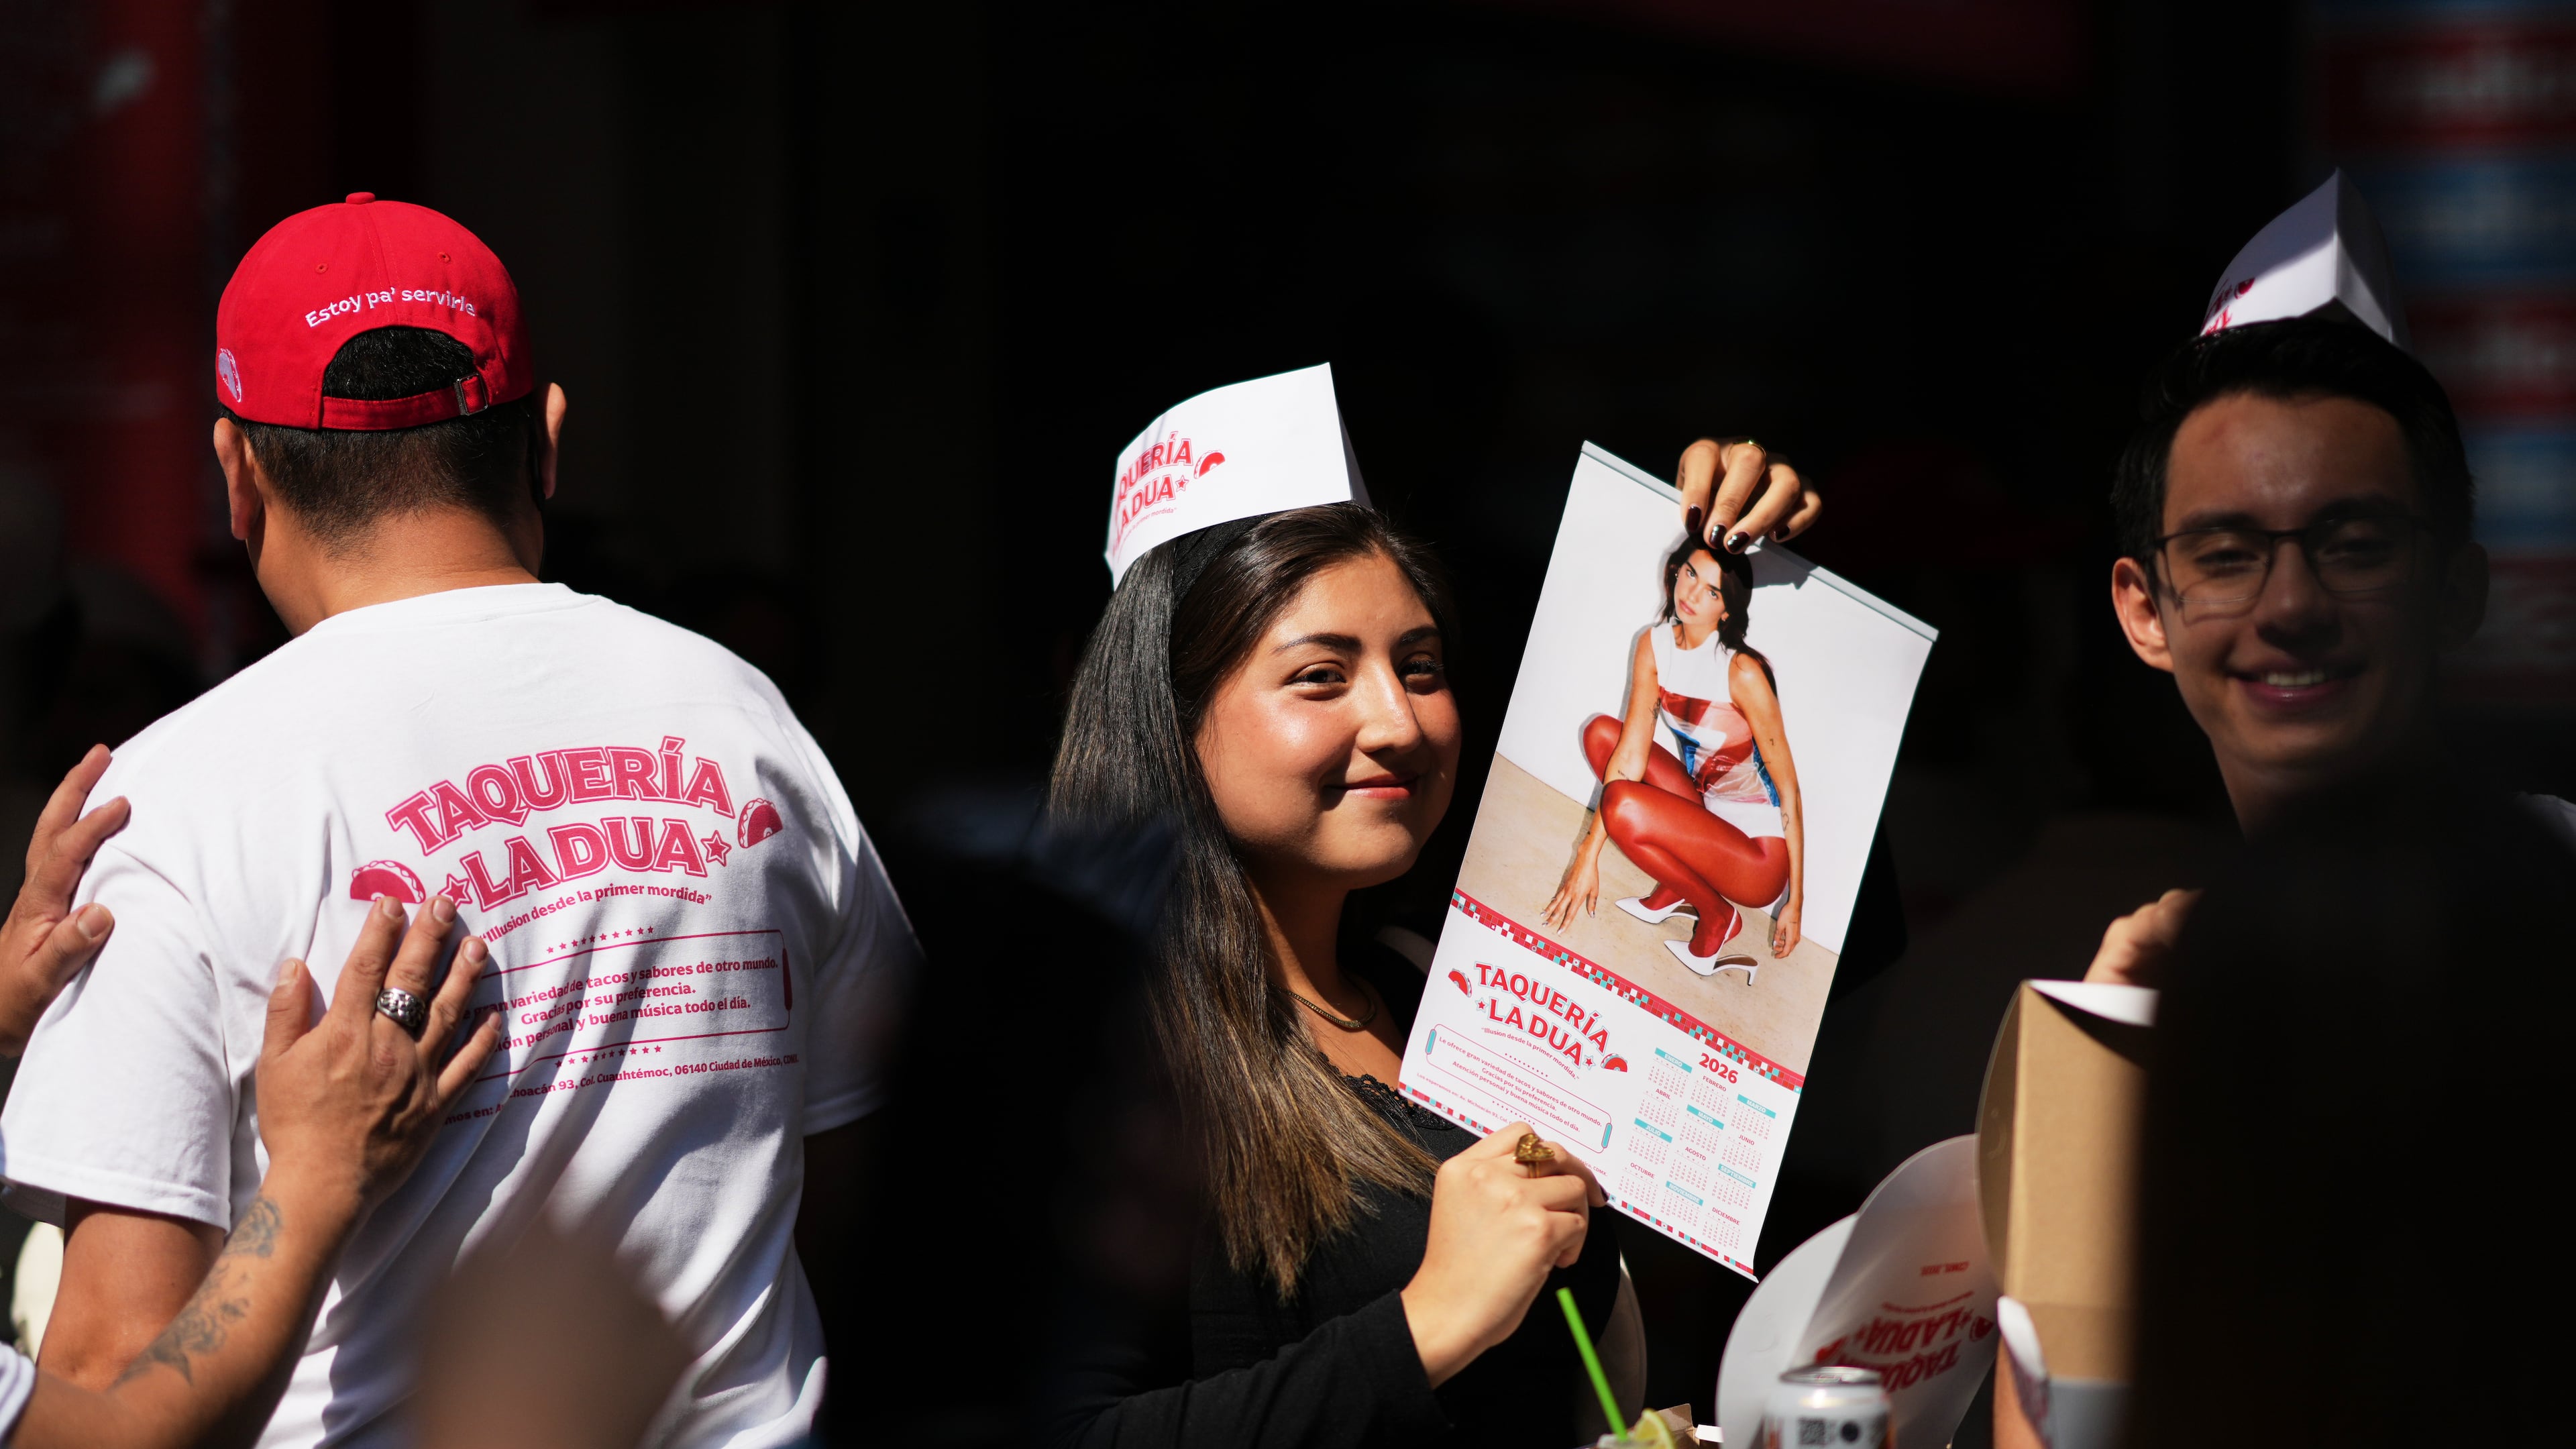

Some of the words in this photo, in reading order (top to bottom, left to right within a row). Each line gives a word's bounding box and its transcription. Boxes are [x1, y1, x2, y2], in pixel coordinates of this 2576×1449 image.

[305, 294, 362, 328] Estoy
[365, 286, 396, 309] pa’
[401, 288, 476, 317] servirle
[1116, 431, 1193, 511] QUERÍA
[1131, 474, 1175, 521] DUA
[386, 735, 736, 857] TAQUERÍA
[531, 896, 576, 920] desde
[577, 890, 593, 902] la
[594, 883, 645, 902] primer
[647, 885, 712, 906] mordida”
[511, 981, 570, 1009] variedad
[570, 978, 584, 993] de
[586, 972, 629, 989] tacos
[630, 971, 640, 984] y
[639, 964, 694, 981] sabores
[696, 961, 713, 974] de
[715, 960, 741, 973] otro
[742, 957, 778, 971] mundo.
[521, 1004, 566, 1026] Gracias
[566, 996, 591, 1015] por
[594, 994, 613, 1006] su
[616, 981, 696, 1006] preferencia.
[1474, 961, 1610, 1054] TAQUERÍA
[525, 1018, 574, 1048] personal
[576, 1018, 586, 1031] y
[589, 1010, 629, 1026] buena
[631, 1003, 683, 1019] música
[684, 999, 716, 1014] todo
[717, 998, 729, 1010] el
[729, 996, 751, 1010] día.
[1489, 998, 1524, 1030] LA
[1527, 1013, 1582, 1068] DUA
[1507, 1033, 1526, 1044] desde
[1526, 1040, 1532, 1048] la
[1532, 1044, 1553, 1059] primer
[1664, 1053, 1682, 1067] ENERO
[558, 1079, 578, 1091] 93,
[580, 1075, 596, 1087] Col.
[596, 1067, 674, 1084] Cuauhtémoc,
[674, 1062, 708, 1076] 06140
[708, 1059, 741, 1072] Ciudad
[741, 1057, 753, 1069] de
[753, 1055, 784, 1068] México,
[1447, 1042, 1466, 1054] ofrece
[1466, 1052, 1481, 1061] gran
[1481, 1060, 1507, 1075] variedad
[1515, 1077, 1532, 1089] tacos
[1536, 1089, 1560, 1104] sabores
[1568, 1106, 1581, 1115] otro
[1580, 1112, 1601, 1126] mundo.
[1698, 1052, 1739, 1084] 2026
[1702, 1075, 1727, 1091] FEBRERO
[1452, 1061, 1479, 1077] Atención
[1479, 1075, 1506, 1091] personal
[1510, 1091, 1529, 1104] buena
[1528, 1102, 1550, 1116] música
[1550, 1112, 1564, 1122] todo
[1482, 1067, 1503, 1082] Gracias
[1503, 1079, 1515, 1087] por
[1521, 1090, 1556, 1111] preferencia.
[1655, 1087, 1672, 1099] ABRIL
[1746, 1099, 1766, 1113] MARZO
[1645, 1124, 1661, 1136] JULIO
[1697, 1111, 1713, 1122] MAYO
[1684, 1146, 1707, 1161] AGOSTO
[1737, 1134, 1755, 1145] JUNIO
[1629, 1162, 1655, 1178] OCTUBRE
[1720, 1165, 1754, 1186] SEPTIEMBRE
[1668, 1183, 1700, 1203] NOVIEMBRE
[1711, 1206, 1740, 1225] DICIEMBRE
